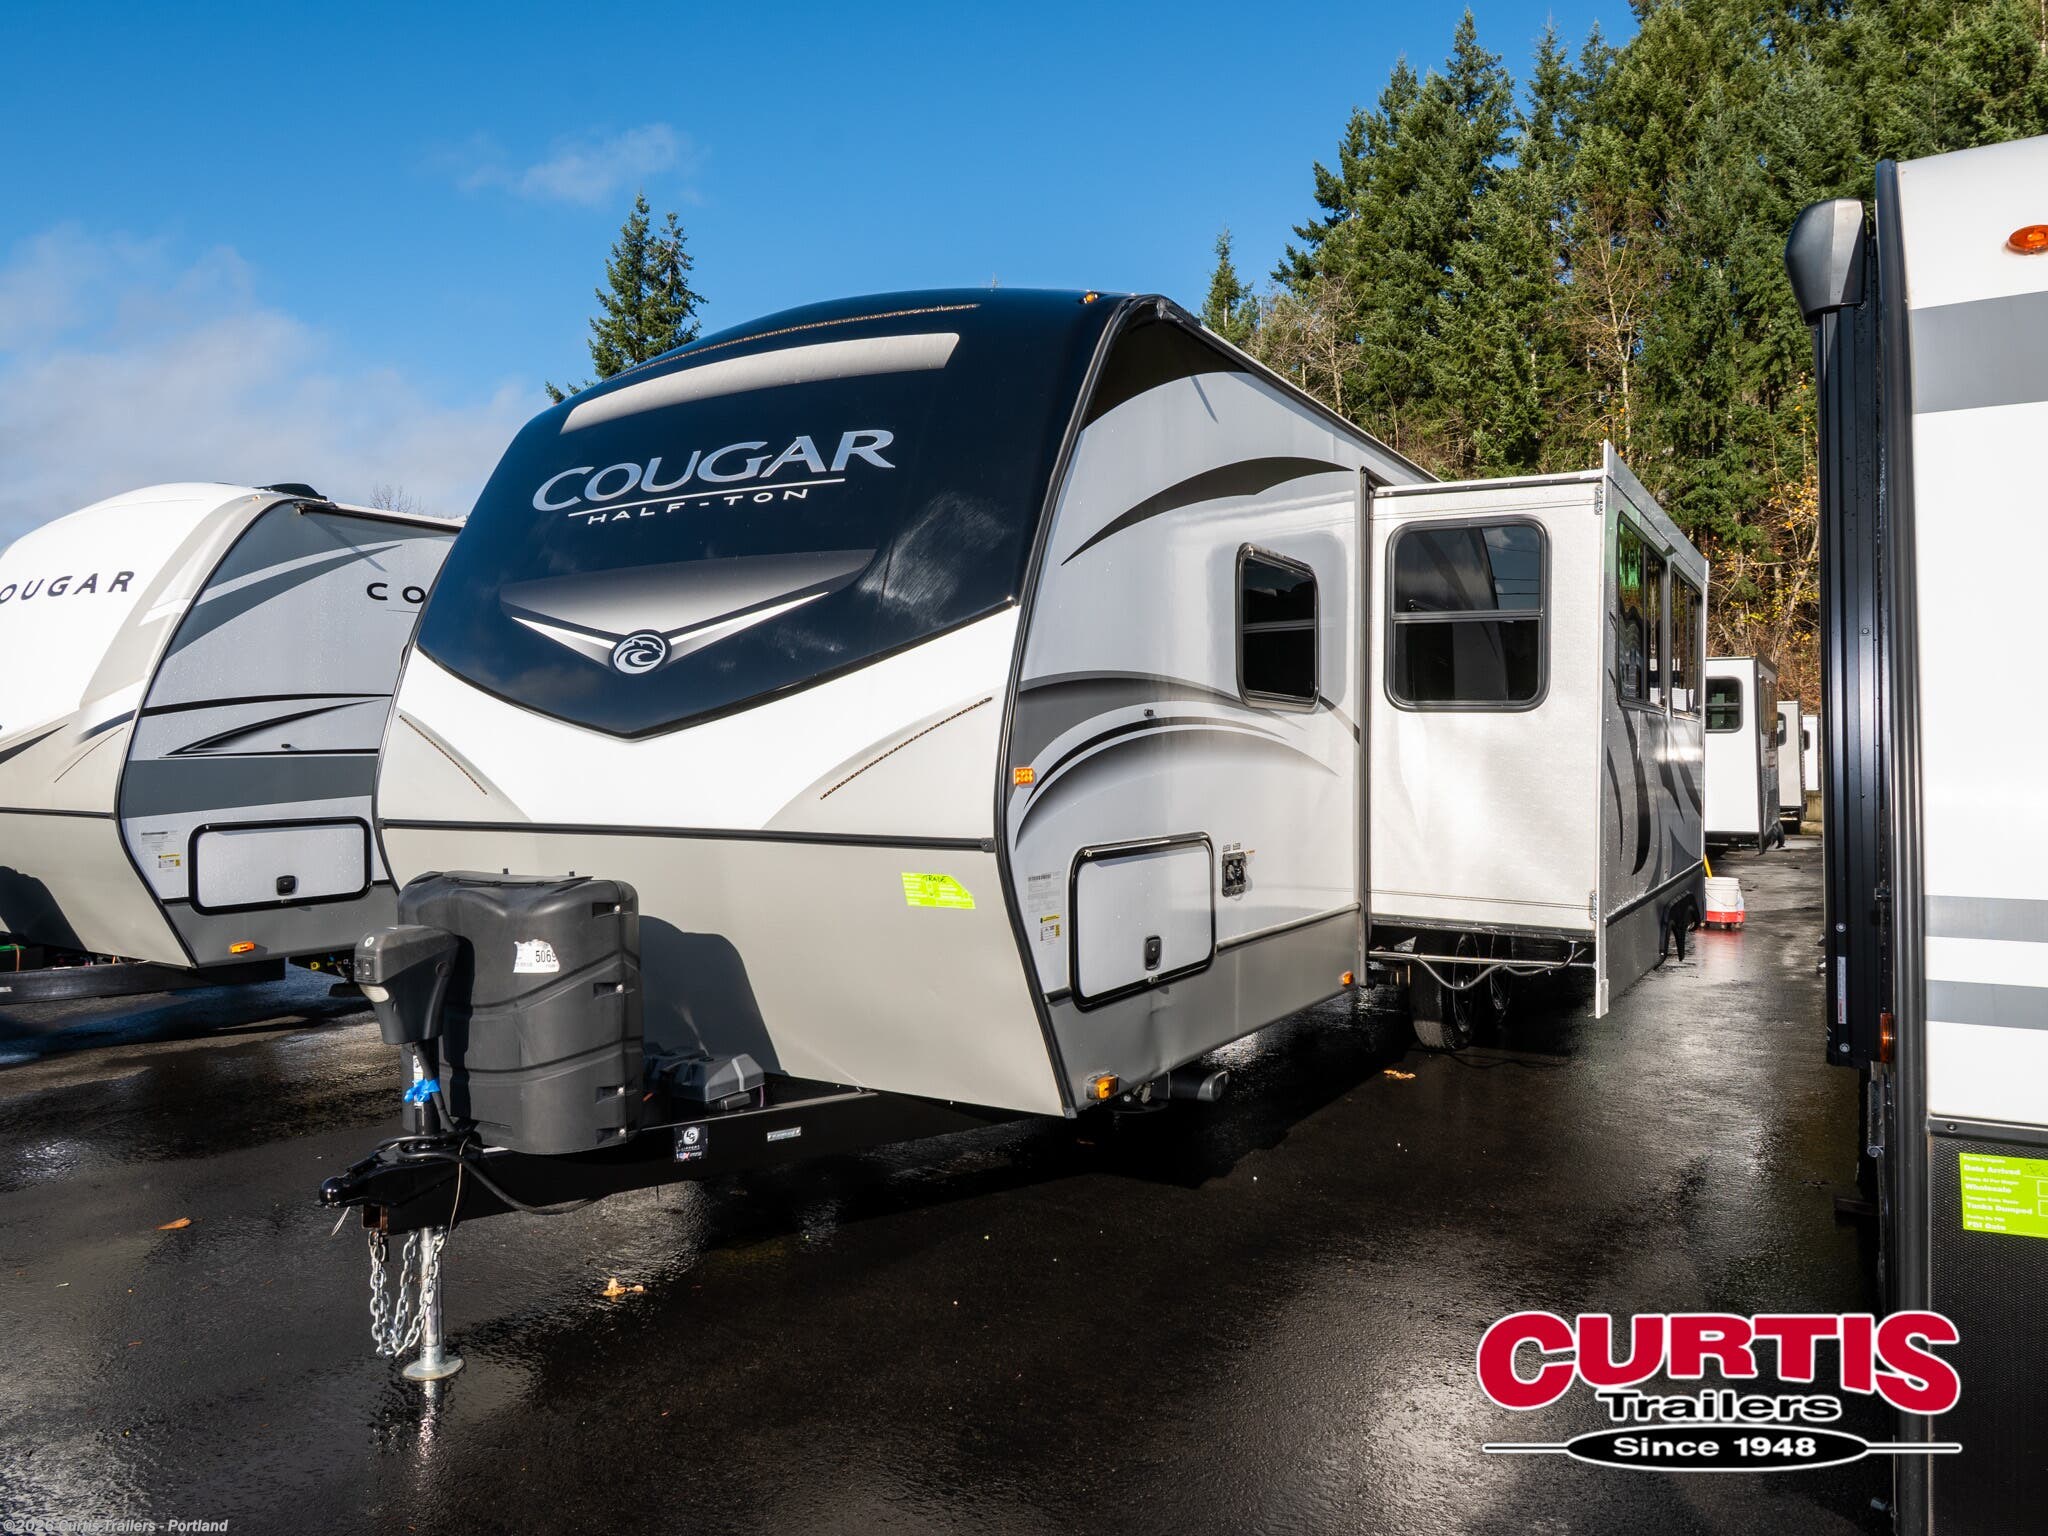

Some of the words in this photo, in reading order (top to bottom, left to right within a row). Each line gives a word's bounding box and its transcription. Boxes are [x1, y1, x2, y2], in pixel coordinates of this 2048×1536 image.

[532, 429, 896, 512] COUGAR
[587, 488, 809, 526] HALF-TON
[1995, 1205, 2033, 1215] Dumped
